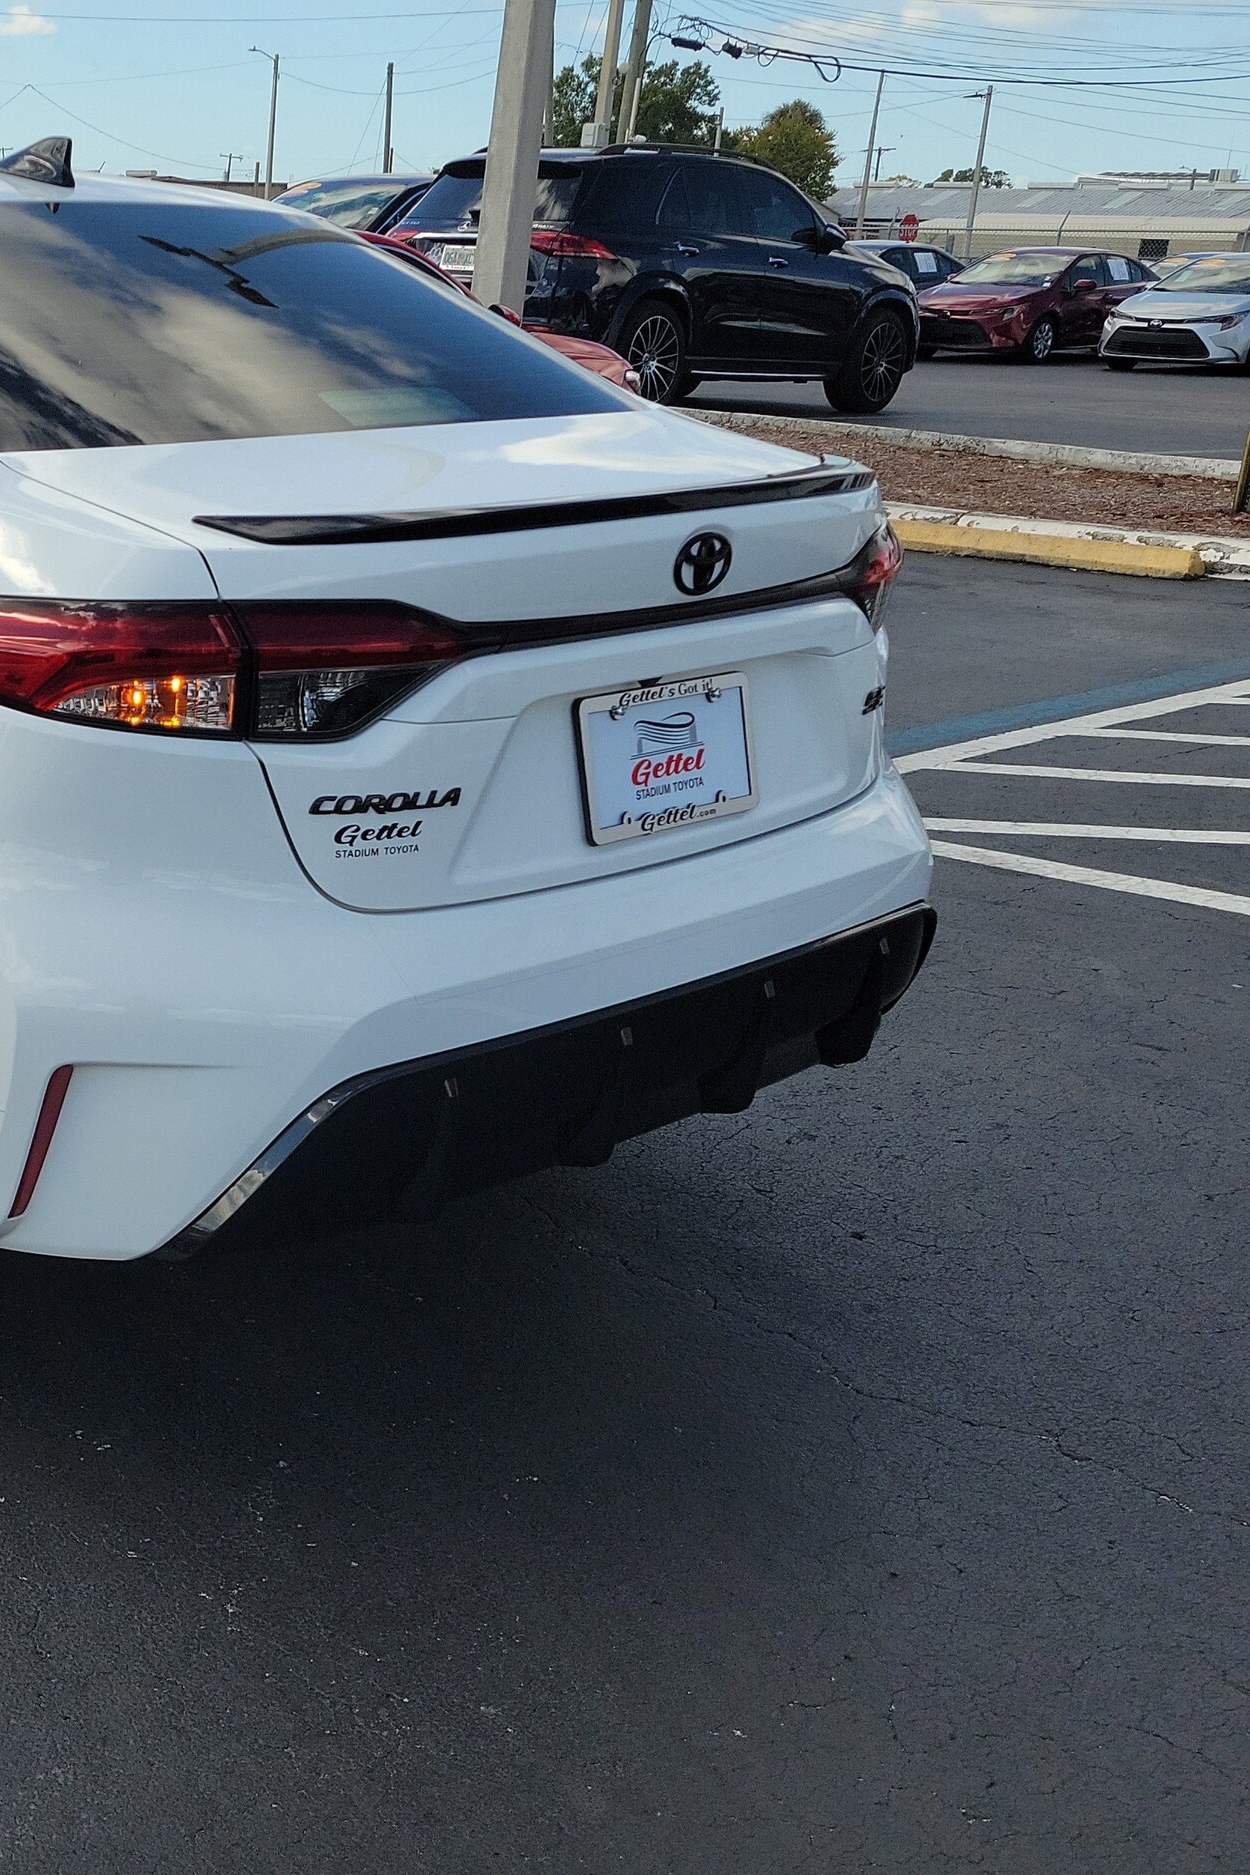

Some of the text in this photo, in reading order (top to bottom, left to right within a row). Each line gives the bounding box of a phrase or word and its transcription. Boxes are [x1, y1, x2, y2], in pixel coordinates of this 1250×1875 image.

[618, 678, 713, 707] Gettel's Got it!
[631, 748, 706, 787] Gettel
[308, 787, 462, 815] COROLLA
[635, 776, 705, 801] STADIUM TOYOTA
[333, 820, 423, 847] Gettel
[334, 844, 420, 859] STADIUM TOYOTA
